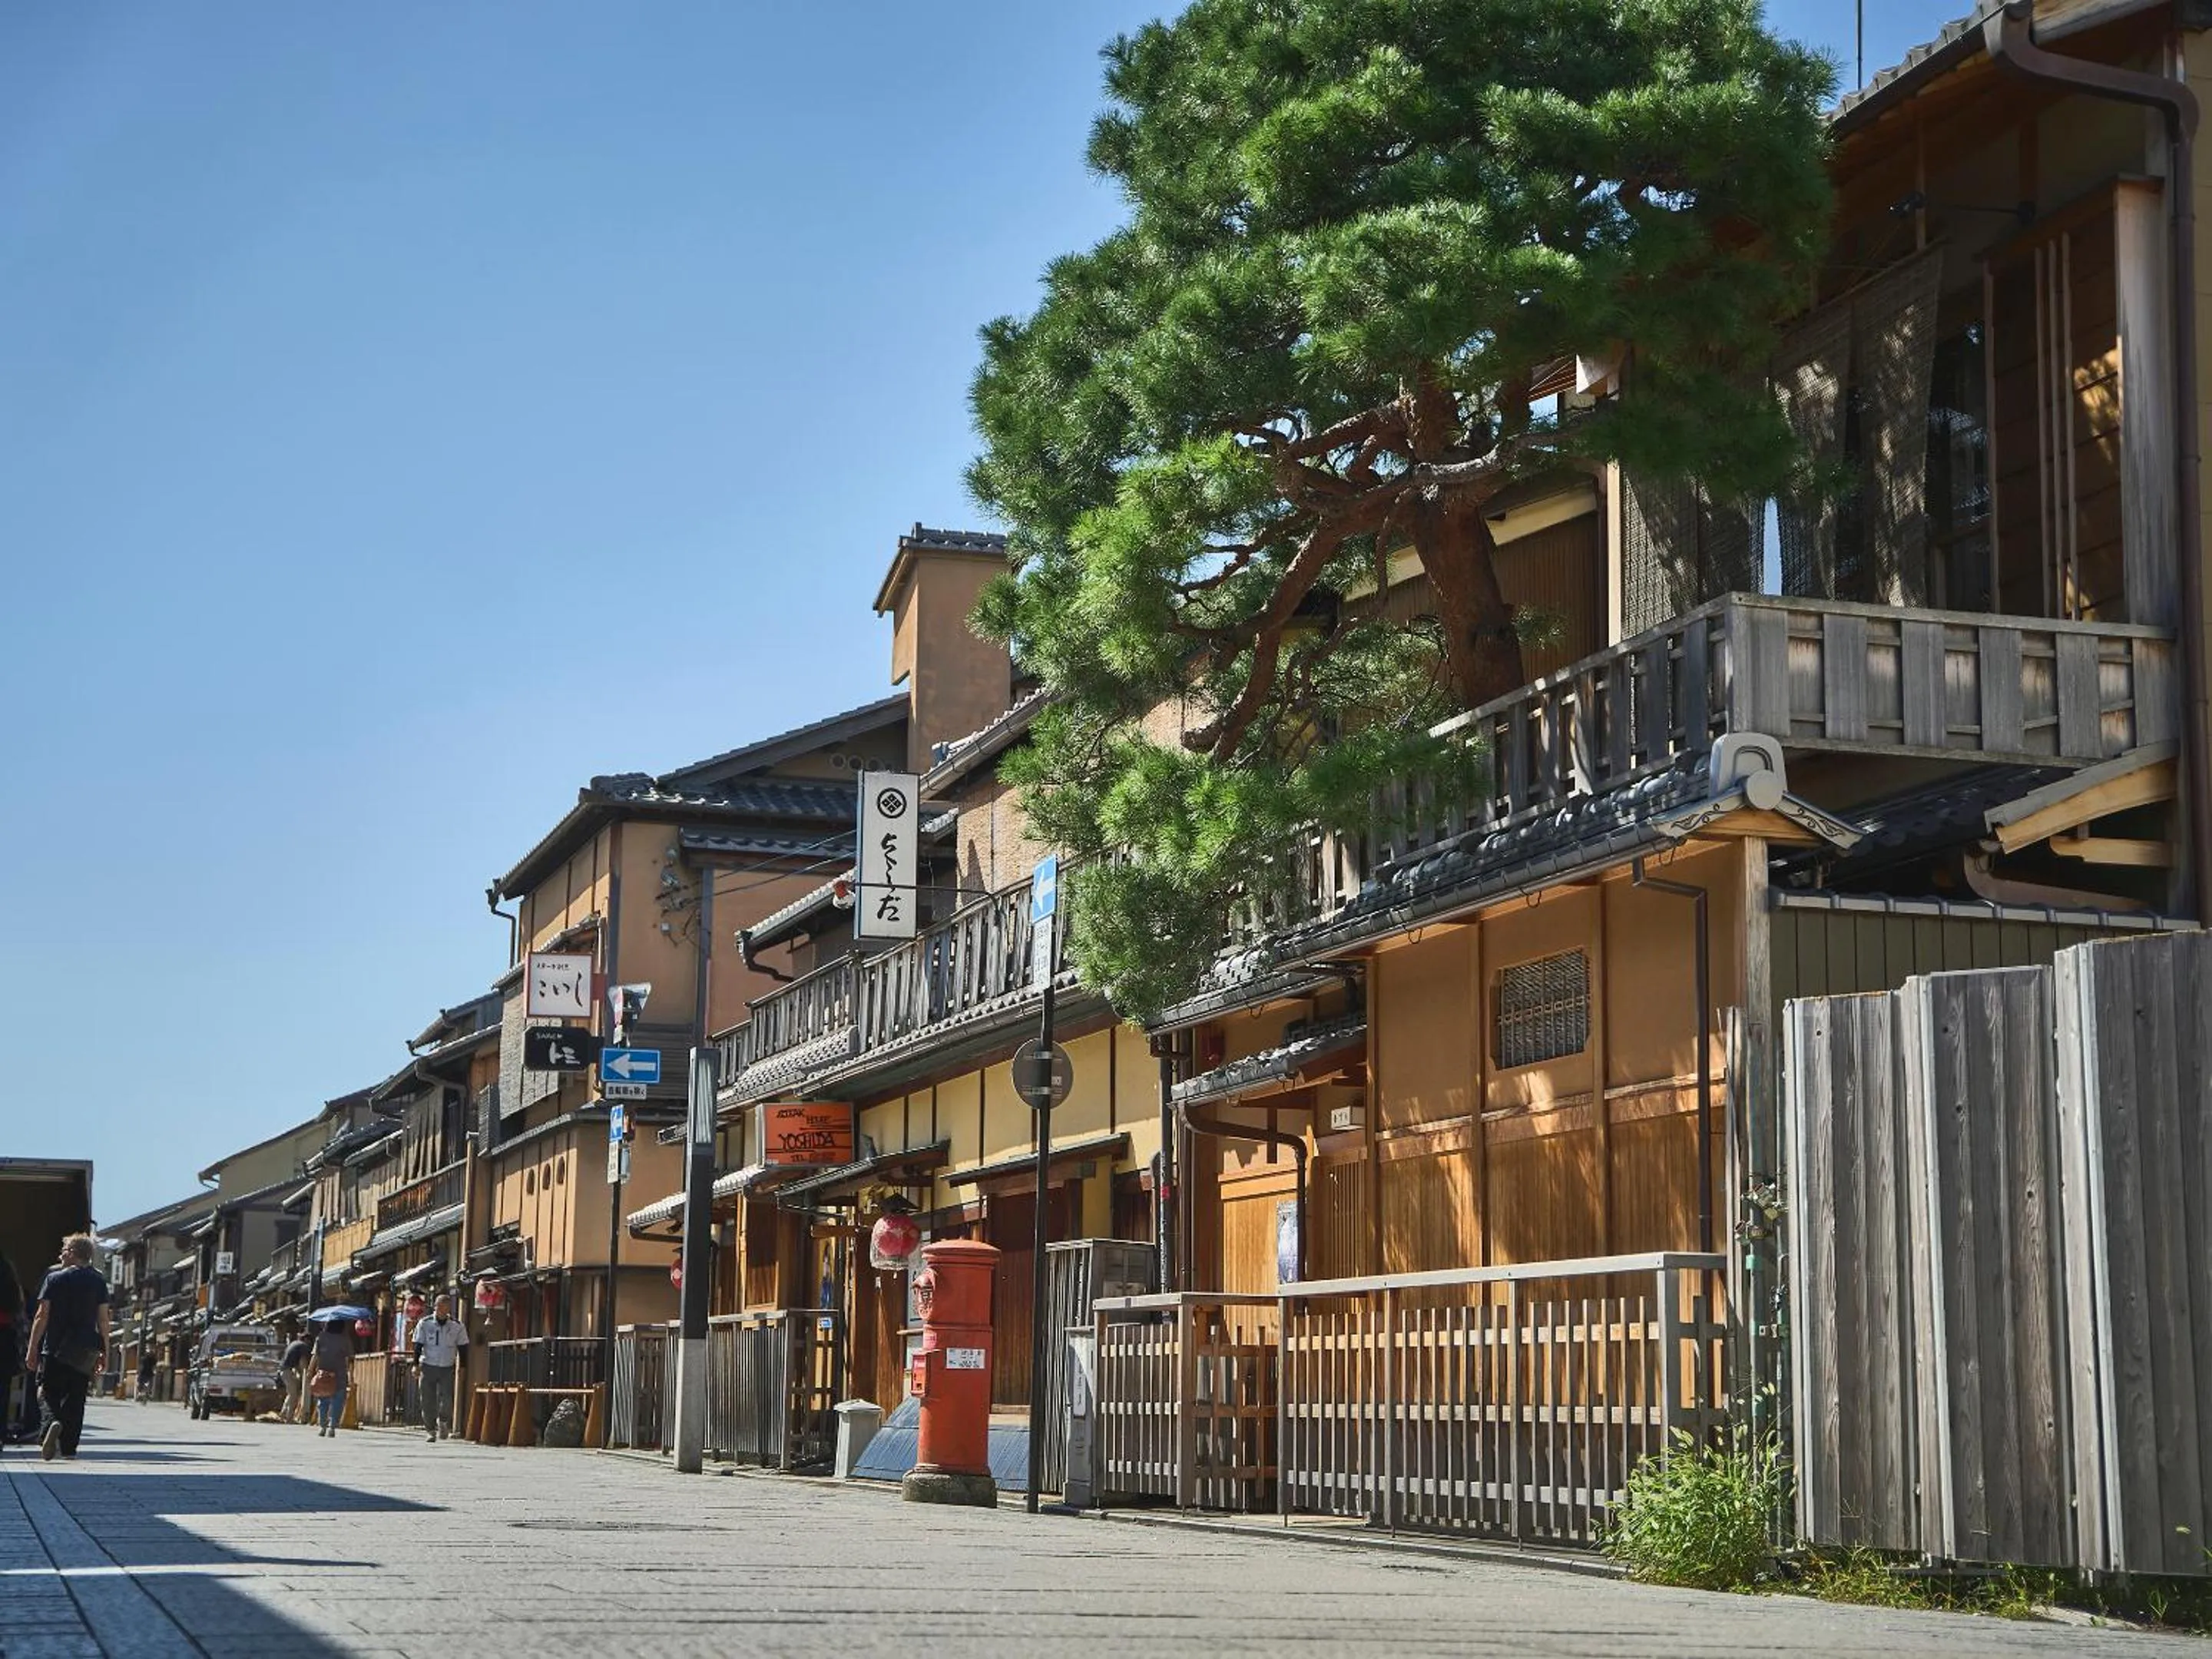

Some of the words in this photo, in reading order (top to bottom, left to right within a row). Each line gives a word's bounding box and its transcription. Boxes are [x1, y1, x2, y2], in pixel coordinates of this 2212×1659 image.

[539, 971, 584, 1008] こいし
[549, 1041, 581, 1065] トミ
[777, 1131, 836, 1152] YOSHIDA
